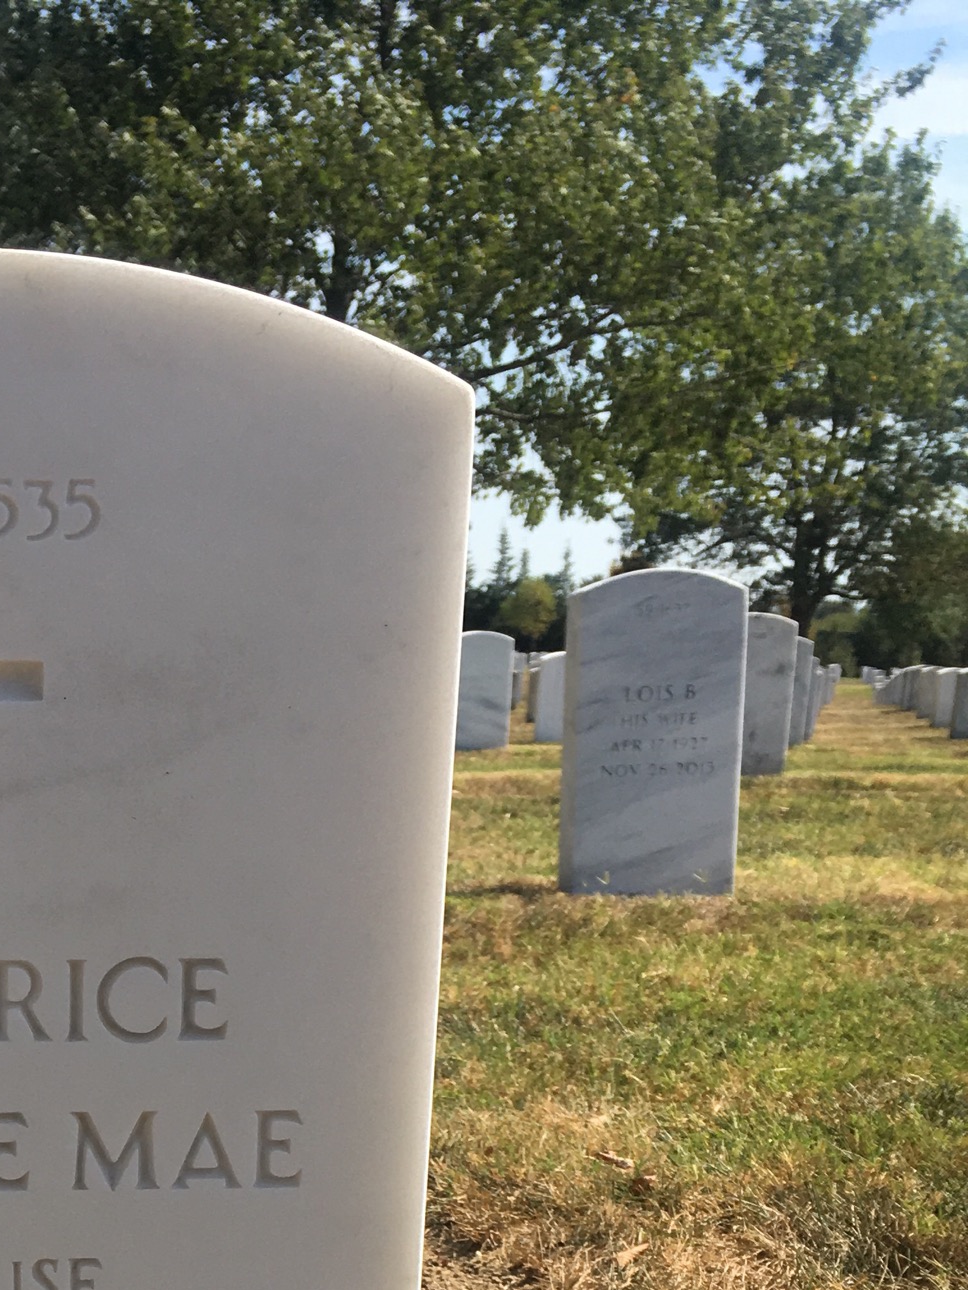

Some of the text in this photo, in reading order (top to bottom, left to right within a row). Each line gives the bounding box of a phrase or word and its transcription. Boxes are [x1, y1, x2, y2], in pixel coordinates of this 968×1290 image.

[622, 683, 697, 702] LOIS B
[620, 712, 697, 727] HIS WIFE
[610, 739, 642, 753] APR
[600, 764, 641, 777] NOV
[70, 1109, 304, 1191] MAE
